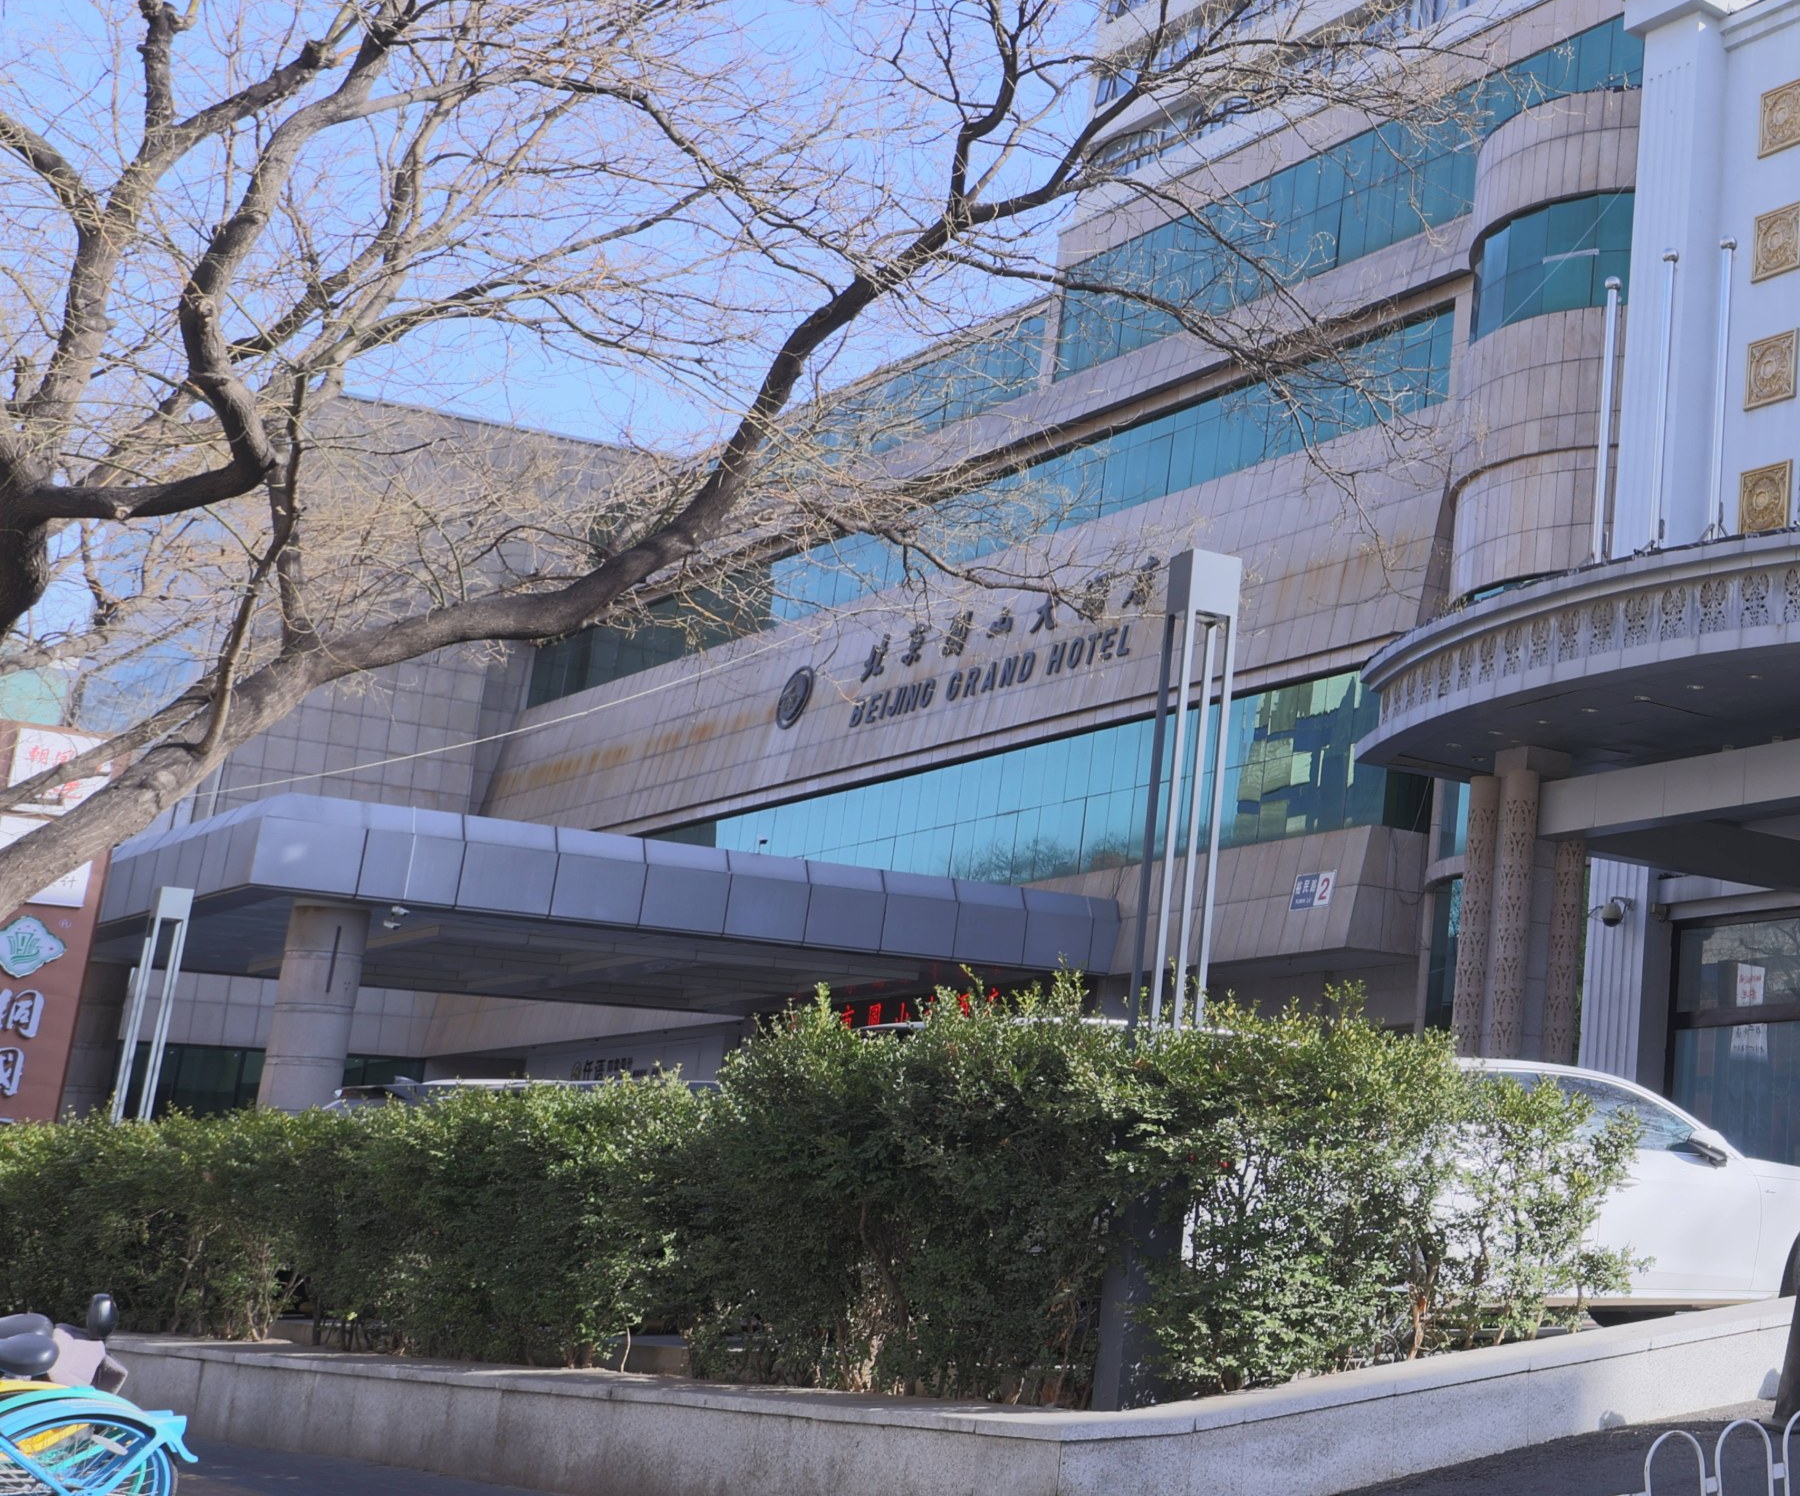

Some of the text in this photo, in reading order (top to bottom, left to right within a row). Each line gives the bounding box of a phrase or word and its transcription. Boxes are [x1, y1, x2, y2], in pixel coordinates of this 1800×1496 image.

[848, 624, 1131, 728] BEIJING GRAND HOTEL
[1318, 878, 1329, 900] 2
